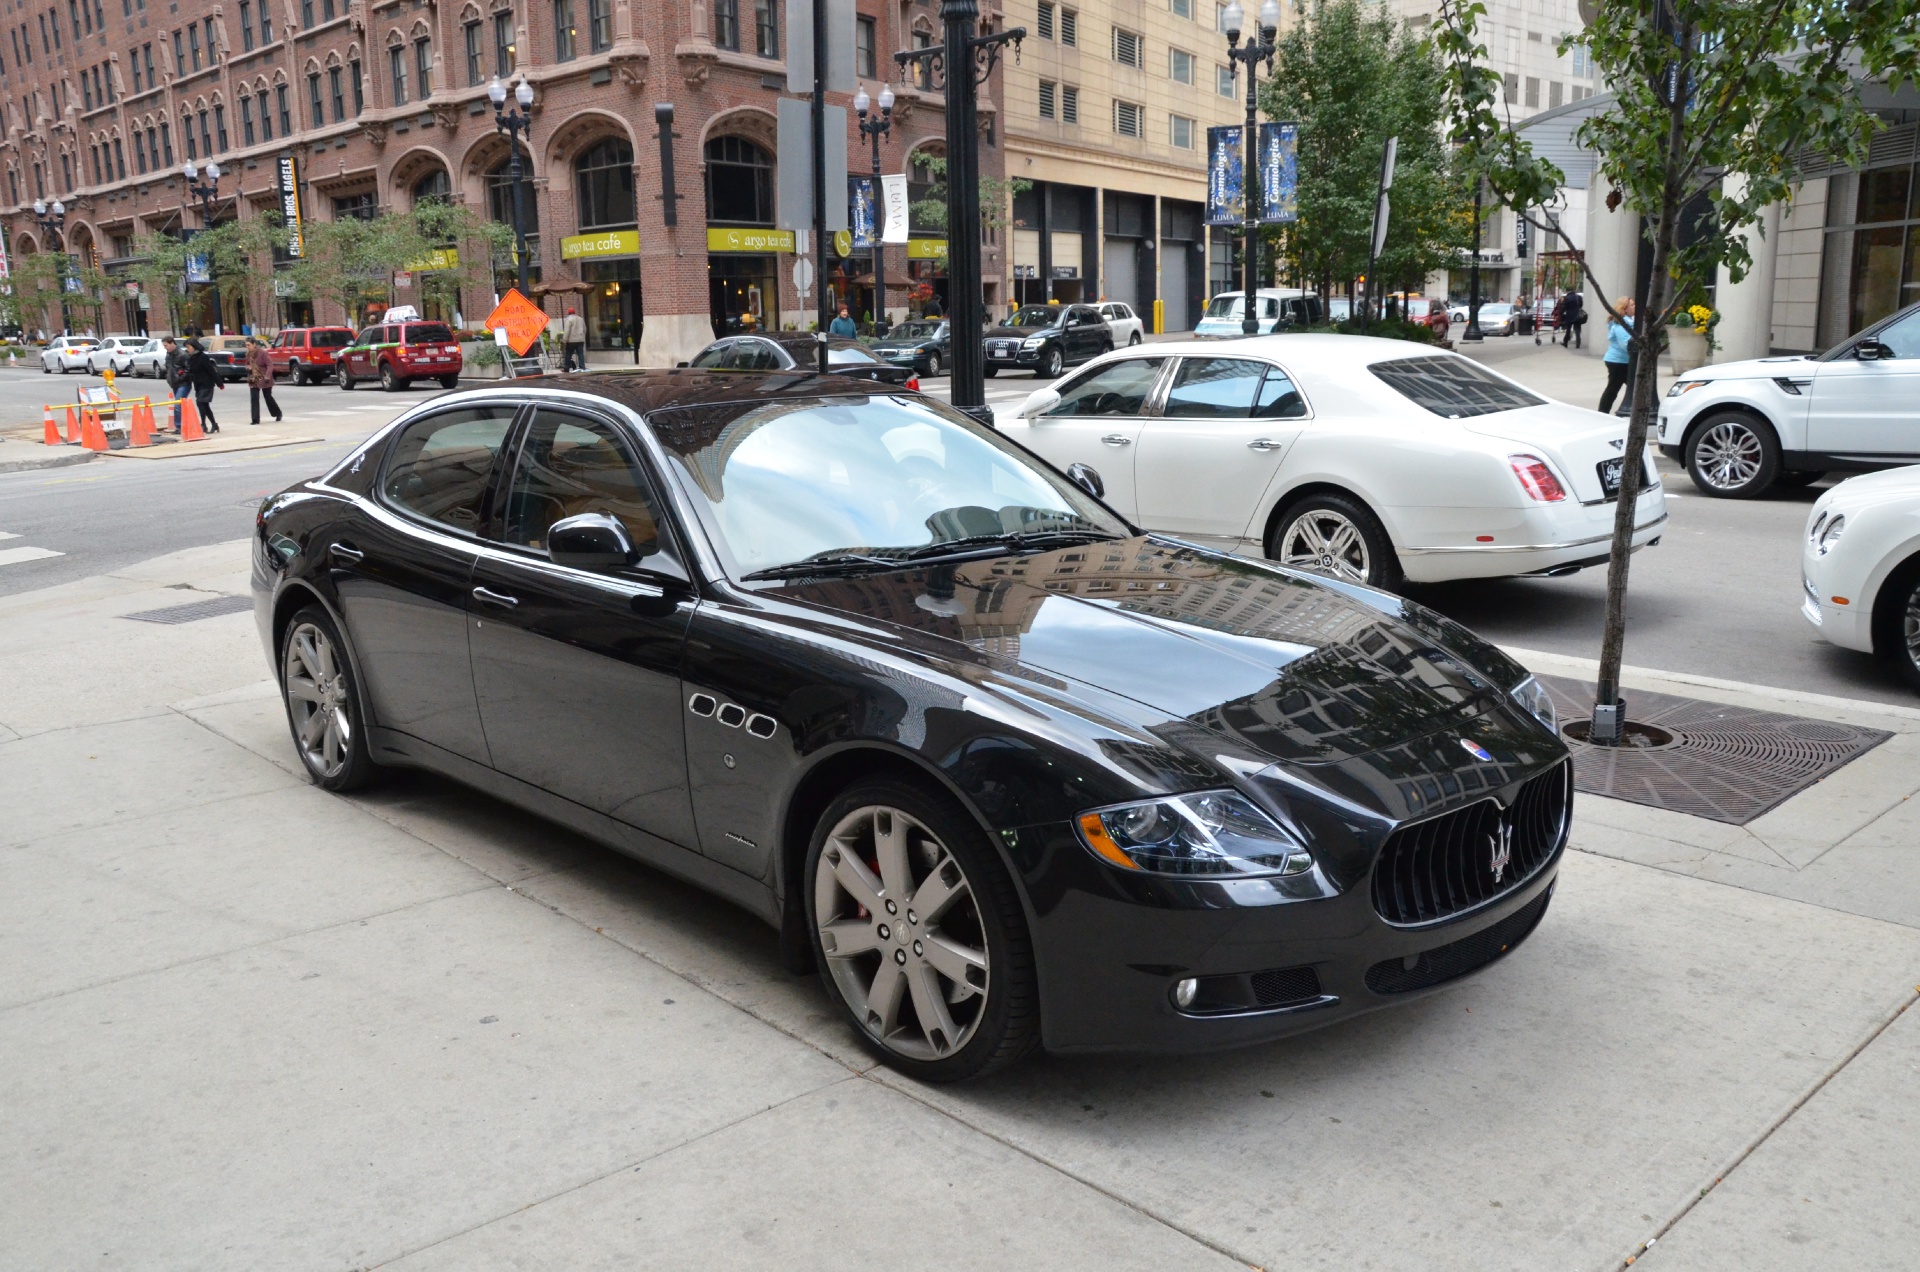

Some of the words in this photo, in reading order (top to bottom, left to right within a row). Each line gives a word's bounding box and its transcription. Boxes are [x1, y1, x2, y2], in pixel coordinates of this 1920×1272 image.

[281, 159, 294, 191] BAGELS
[1216, 142, 1227, 205] Cosmologies
[1270, 138, 1281, 202] Cosmologies
[285, 194, 296, 216] BROS.
[857, 189, 865, 235] Cosmologies
[889, 183, 902, 230] LUMA
[583, 241, 594, 251] tea
[597, 233, 621, 250] café
[745, 235, 766, 249] argo
[768, 235, 778, 246] tea
[1517, 222, 1526, 245] rack
[505, 305, 526, 314] ROAD
[489, 316, 544, 328] CONSTRUCTION
[508, 329, 531, 338] AHEAD
